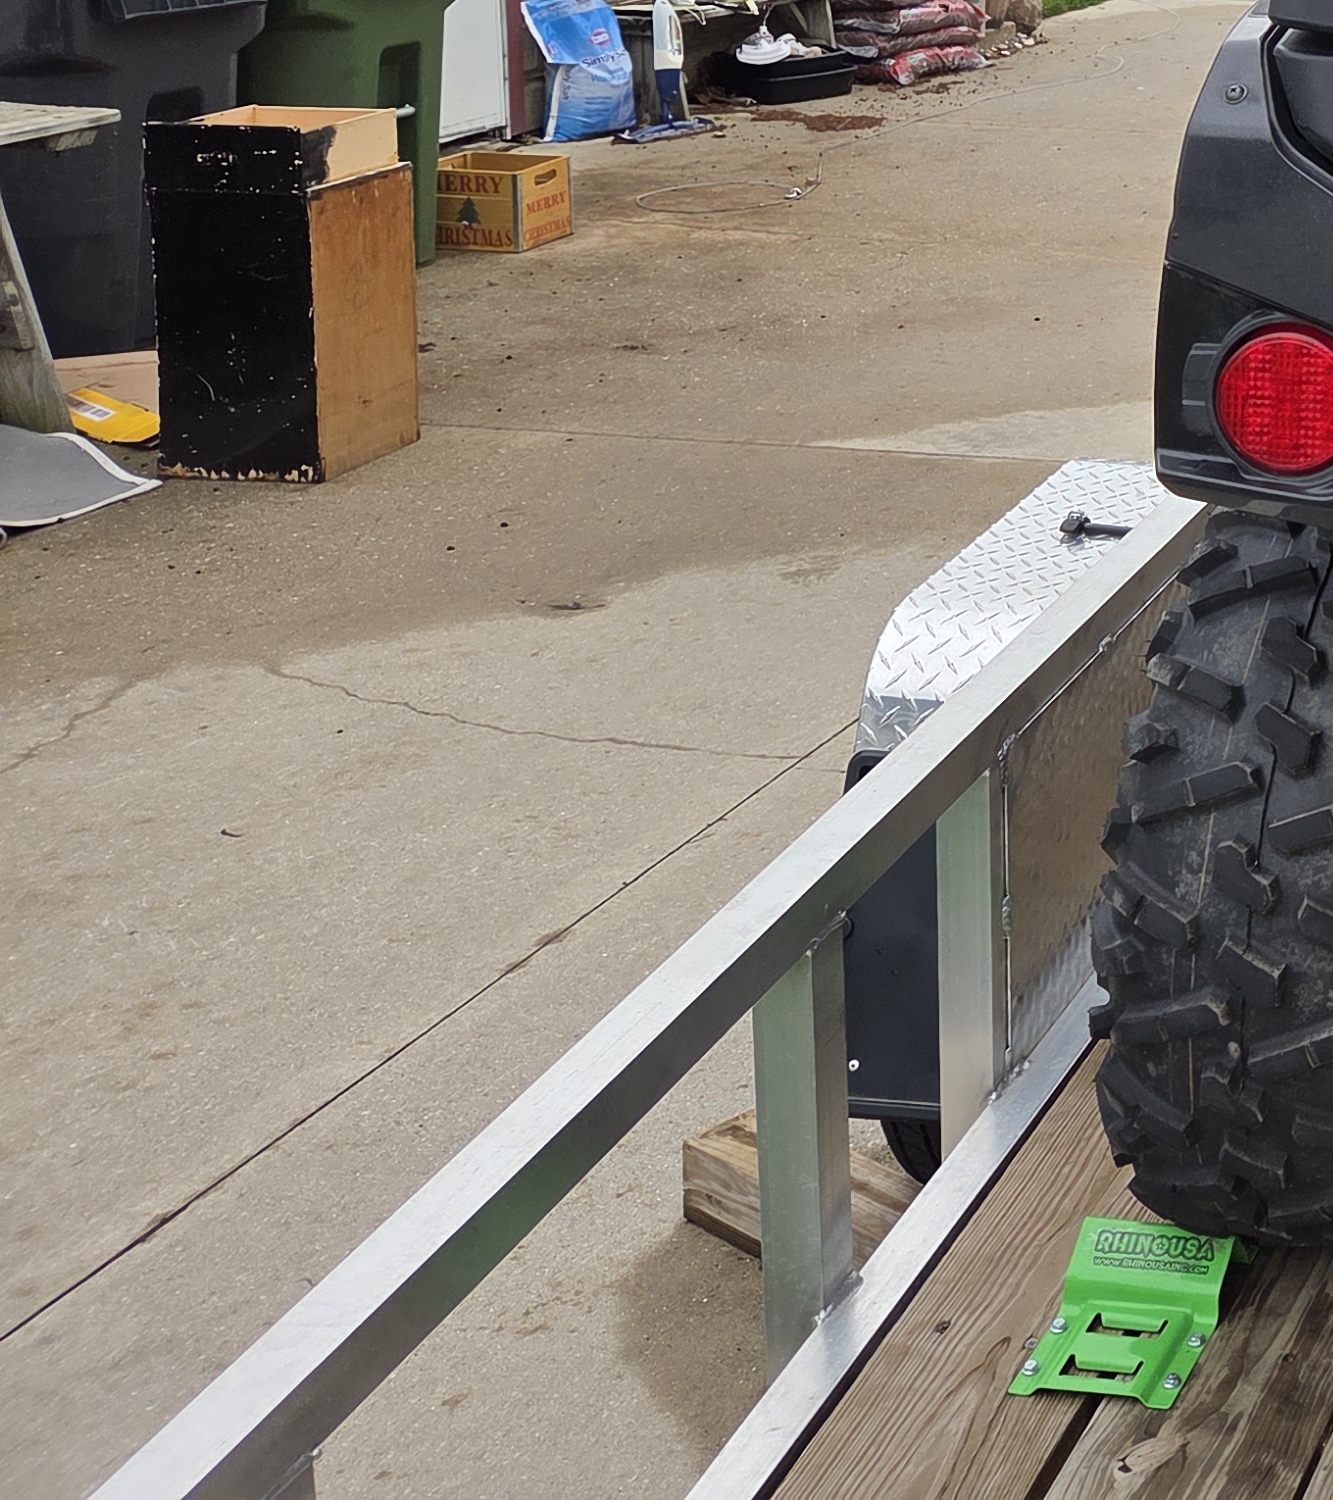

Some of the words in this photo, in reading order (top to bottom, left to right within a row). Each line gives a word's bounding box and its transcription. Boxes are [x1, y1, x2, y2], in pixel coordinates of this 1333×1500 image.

[437, 174, 502, 194] ERRY
[526, 190, 566, 215] MERRY
[436, 226, 513, 248] HRISTMAS
